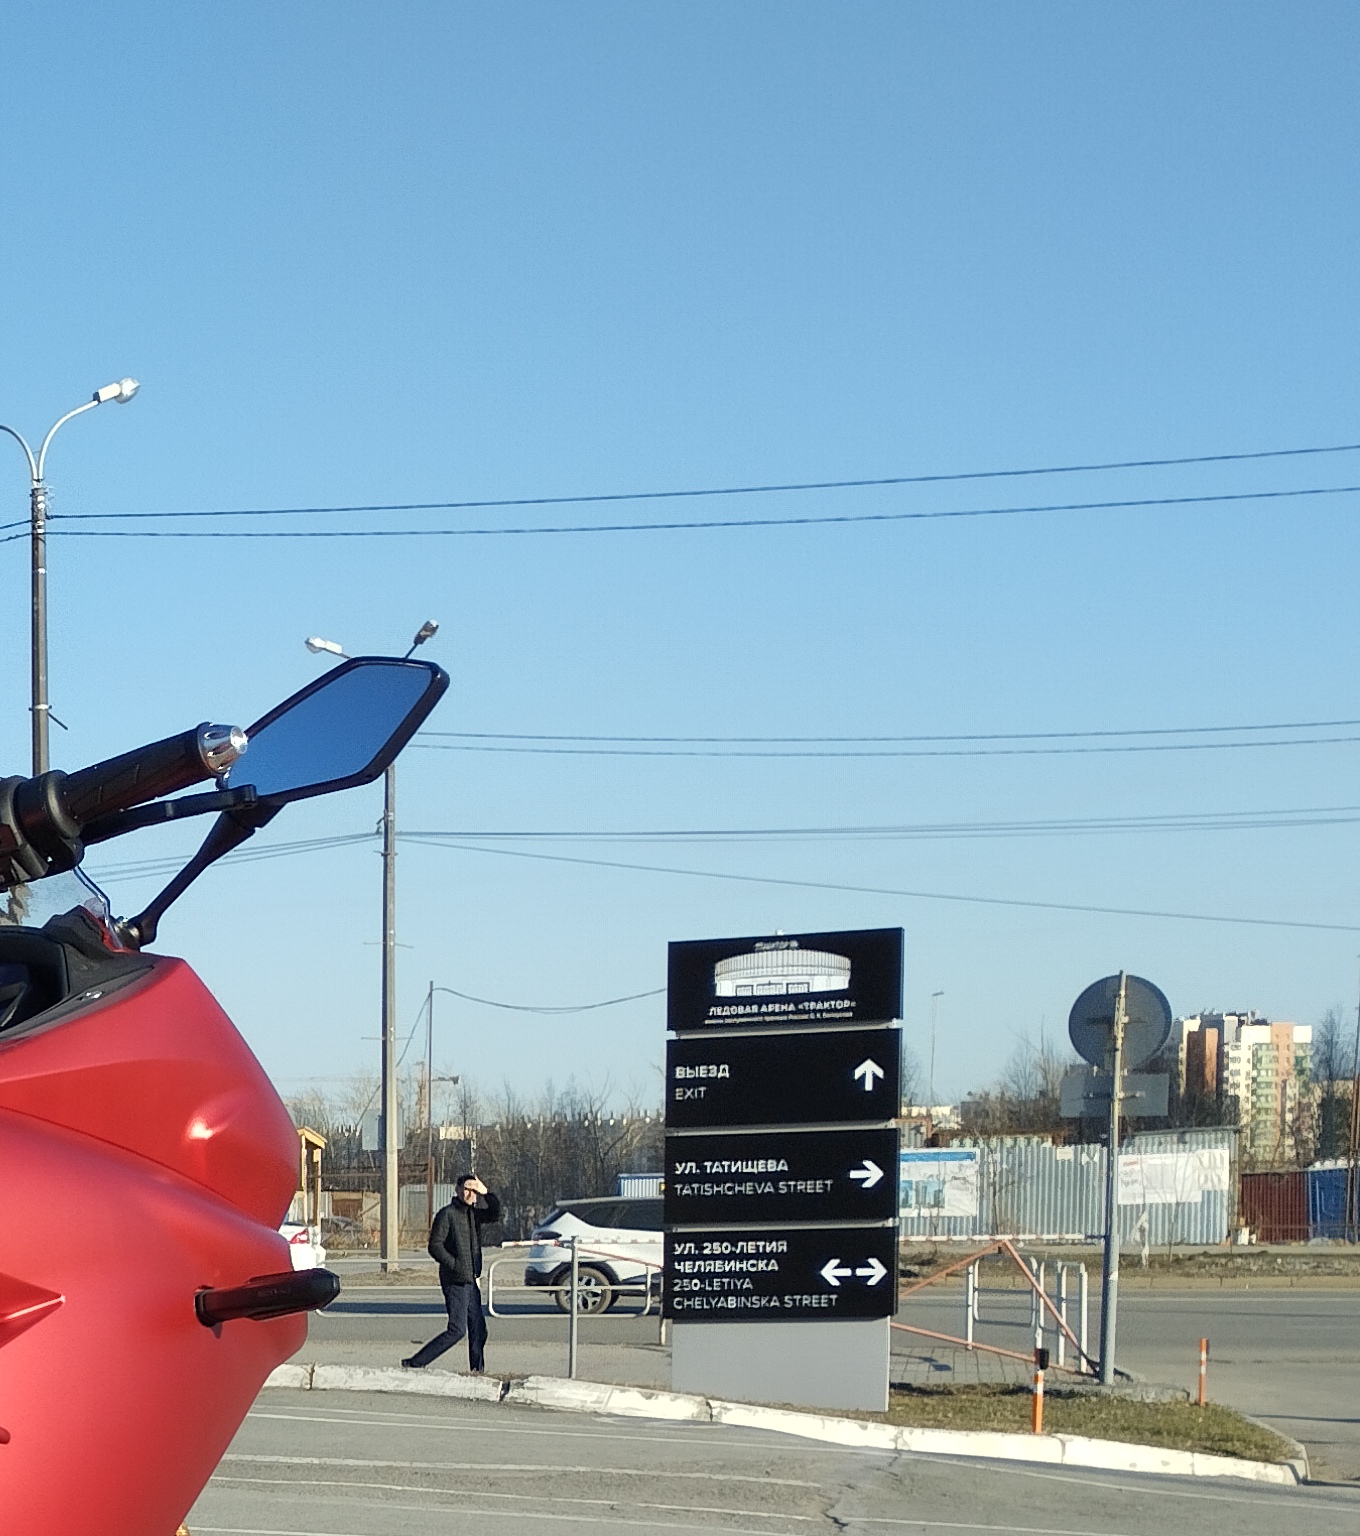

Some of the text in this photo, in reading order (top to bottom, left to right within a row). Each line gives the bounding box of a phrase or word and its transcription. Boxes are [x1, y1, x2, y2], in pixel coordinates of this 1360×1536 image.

[708, 1004, 759, 1017] ЛЕДОВАЯ
[760, 1002, 796, 1013] АРЕНА
[675, 1064, 730, 1079] ВЫЕЗД
[675, 1086, 707, 1101] EXIT
[674, 1158, 789, 1175] УЛ. ТАТИЩЕВА
[674, 1179, 834, 1197] TATISHCHEVA STREET
[673, 1240, 788, 1255] УЛ. 250-ЛЕТИЯ
[674, 1259, 779, 1273] ЧЕЛЯБИНСКА
[672, 1277, 754, 1292] 250-LETIYA
[672, 1294, 839, 1310] CHELYABINSKA STREET
